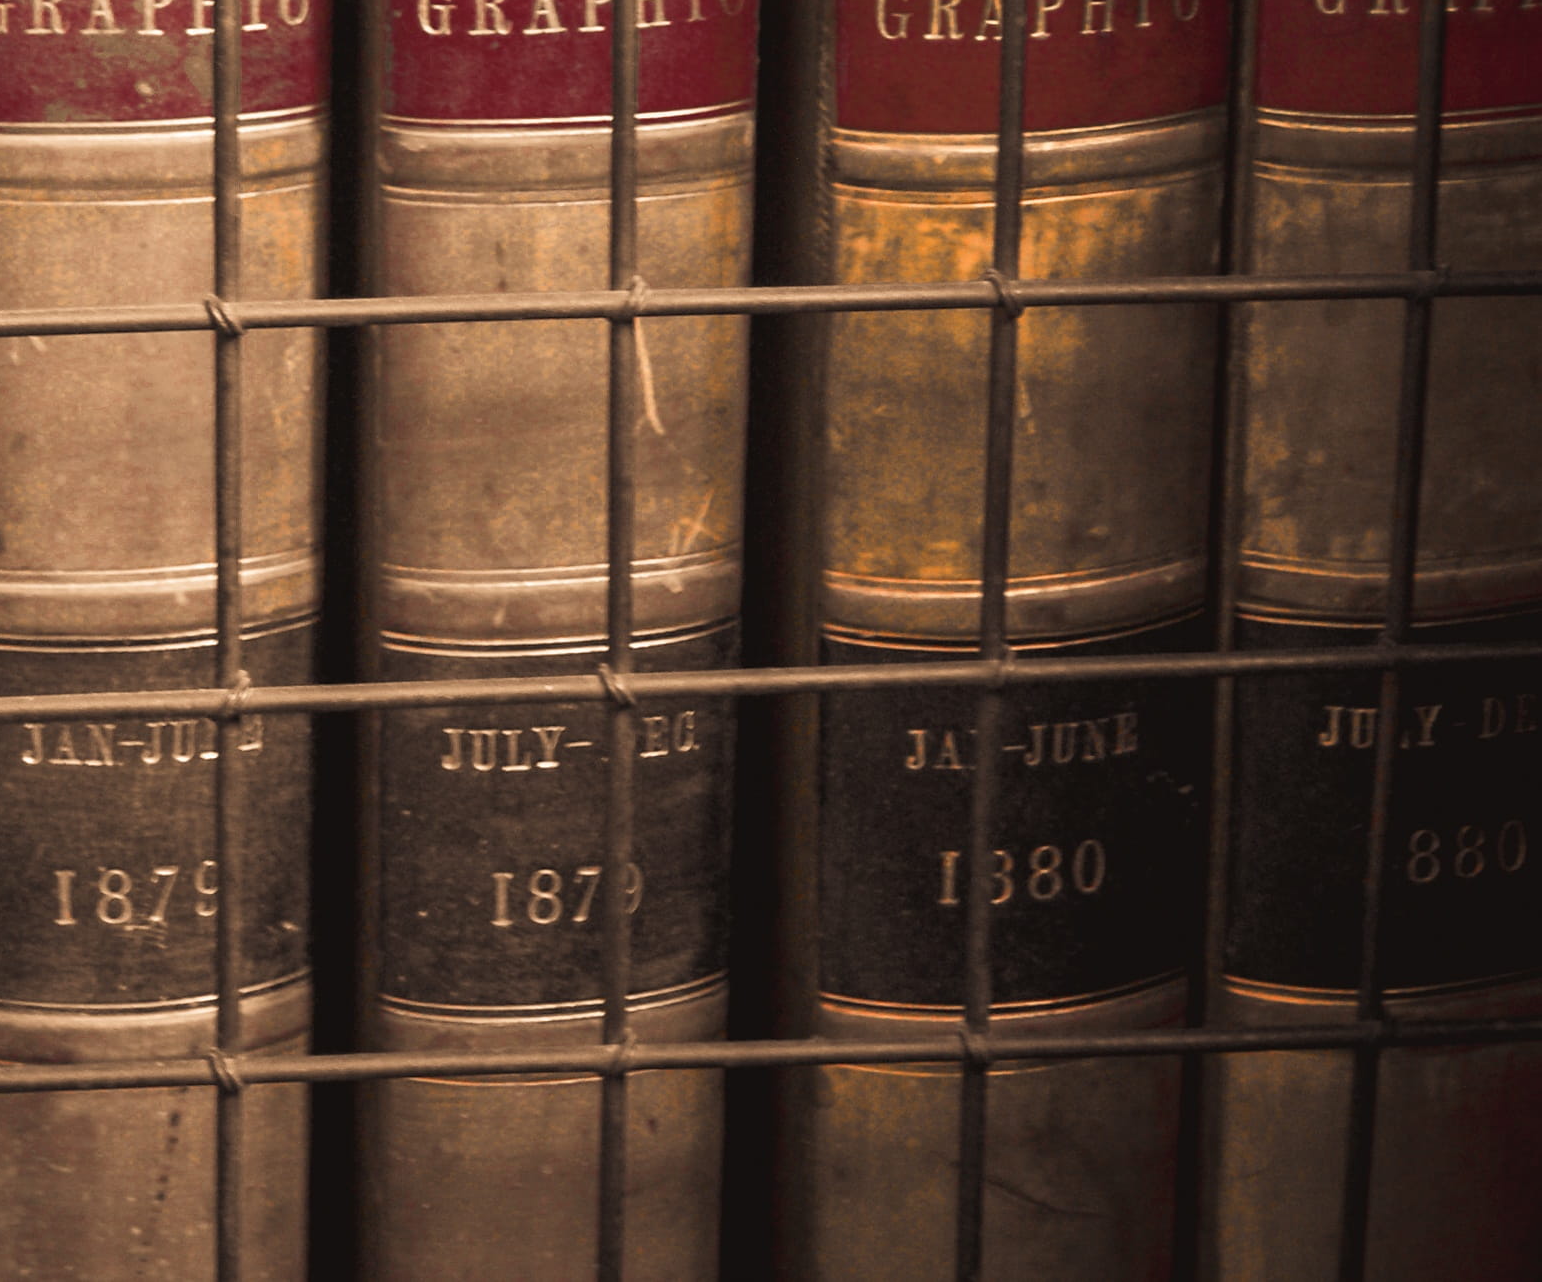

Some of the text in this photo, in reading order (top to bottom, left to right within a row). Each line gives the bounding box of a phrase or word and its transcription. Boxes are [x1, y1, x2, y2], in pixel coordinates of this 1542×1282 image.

[441, 711, 696, 771] JULY-EC
[905, 712, 1139, 770] JA-JUNE
[1407, 819, 1527, 885] 880
